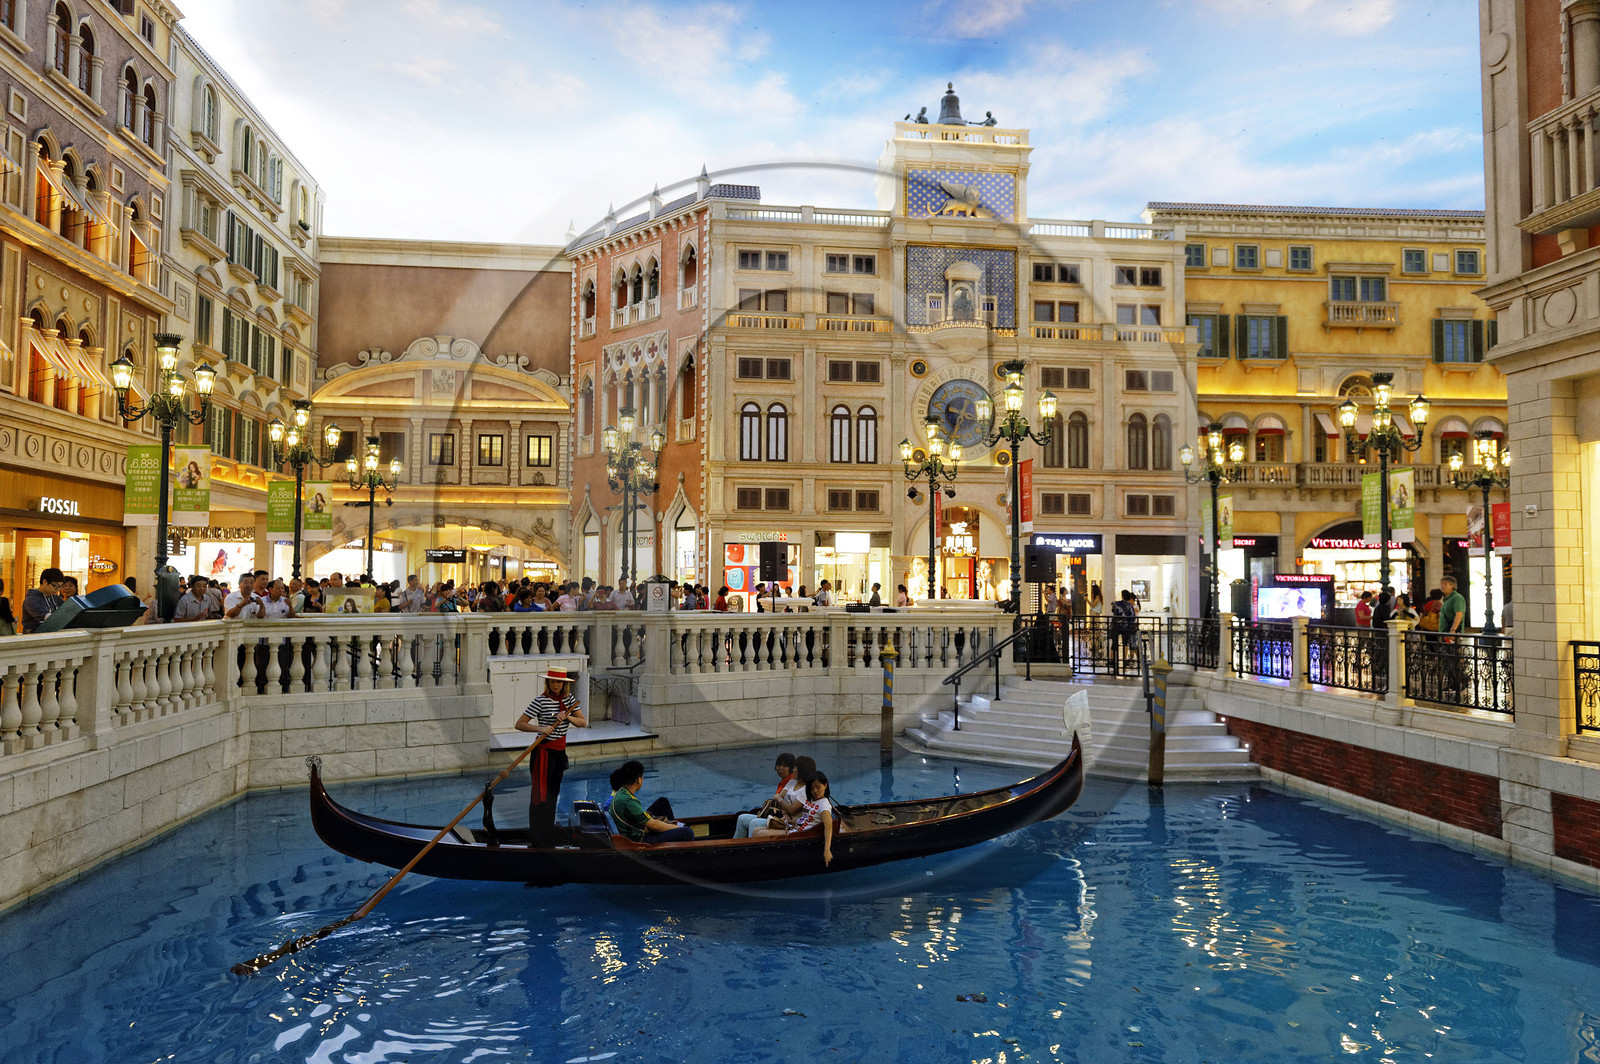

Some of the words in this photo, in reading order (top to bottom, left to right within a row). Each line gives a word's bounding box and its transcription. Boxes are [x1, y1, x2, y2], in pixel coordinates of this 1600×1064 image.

[40, 496, 80, 516] FOSSIL
[620, 536, 649, 546] stch
[739, 531, 779, 541] swatch
[1233, 538, 1256, 546] SECRET
[1311, 538, 1366, 548] VICTORIA'S
